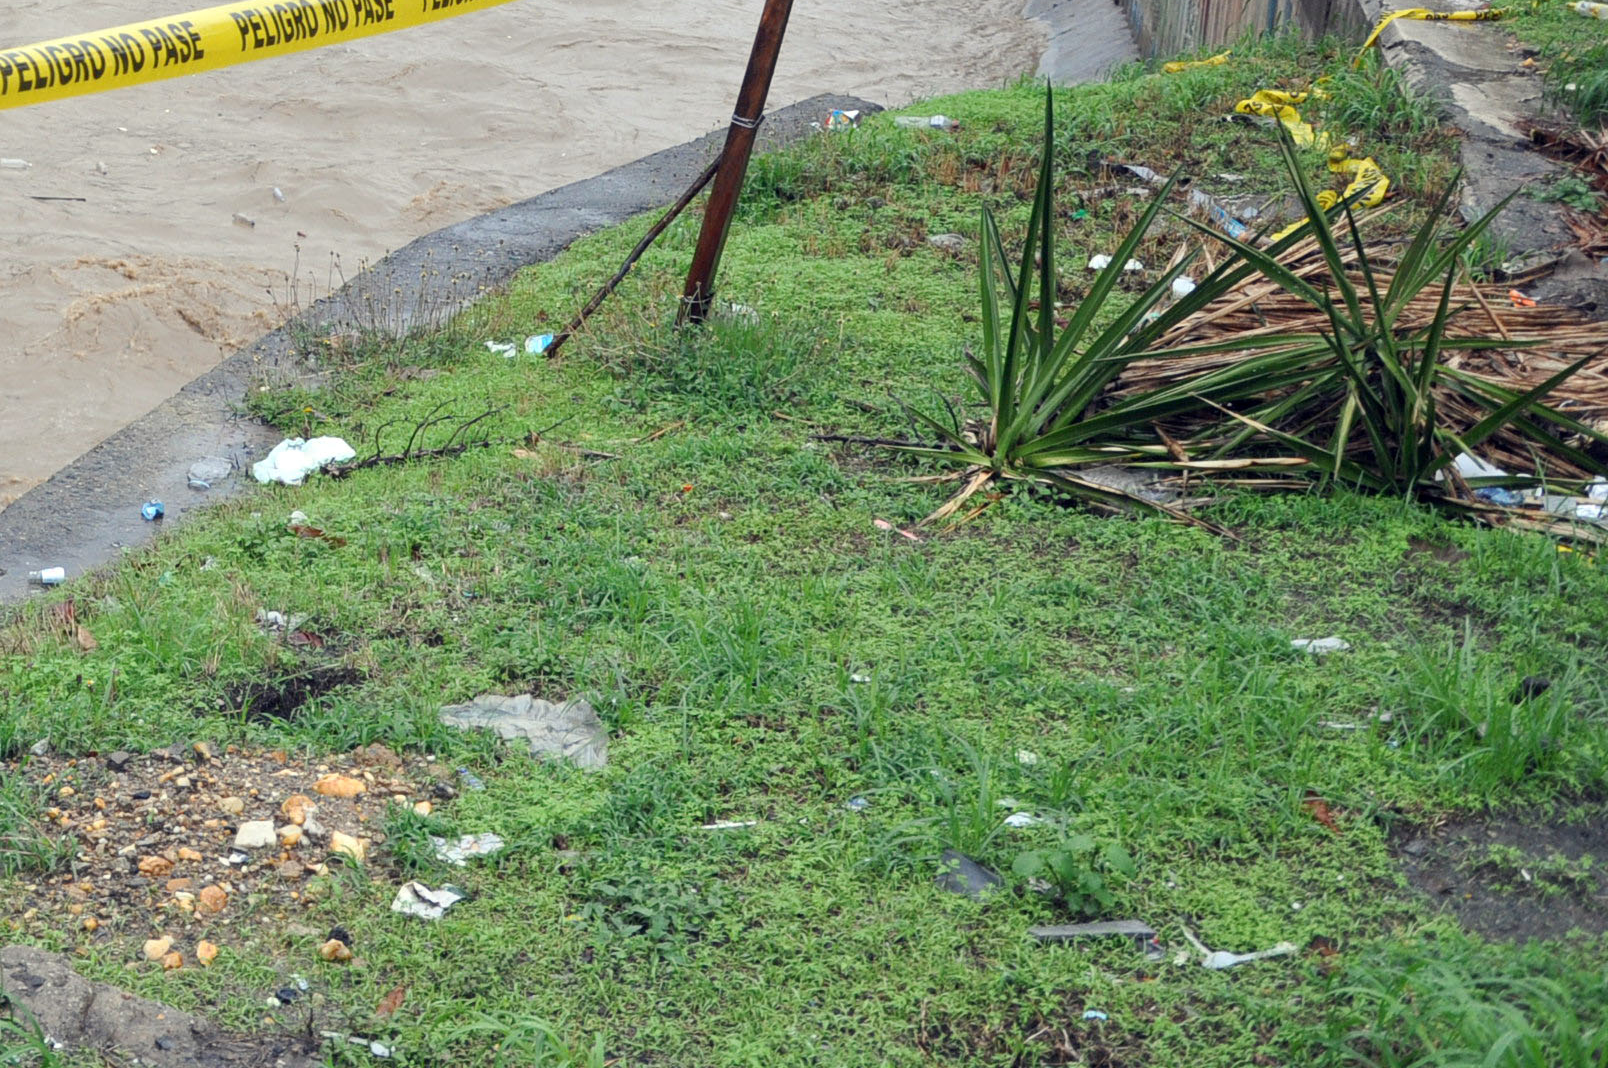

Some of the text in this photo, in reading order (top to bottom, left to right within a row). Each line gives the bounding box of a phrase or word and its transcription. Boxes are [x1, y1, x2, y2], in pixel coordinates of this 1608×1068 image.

[100, 33, 146, 76] NO
[139, 21, 204, 68] PASE
[230, 0, 319, 52] PELIGRO
